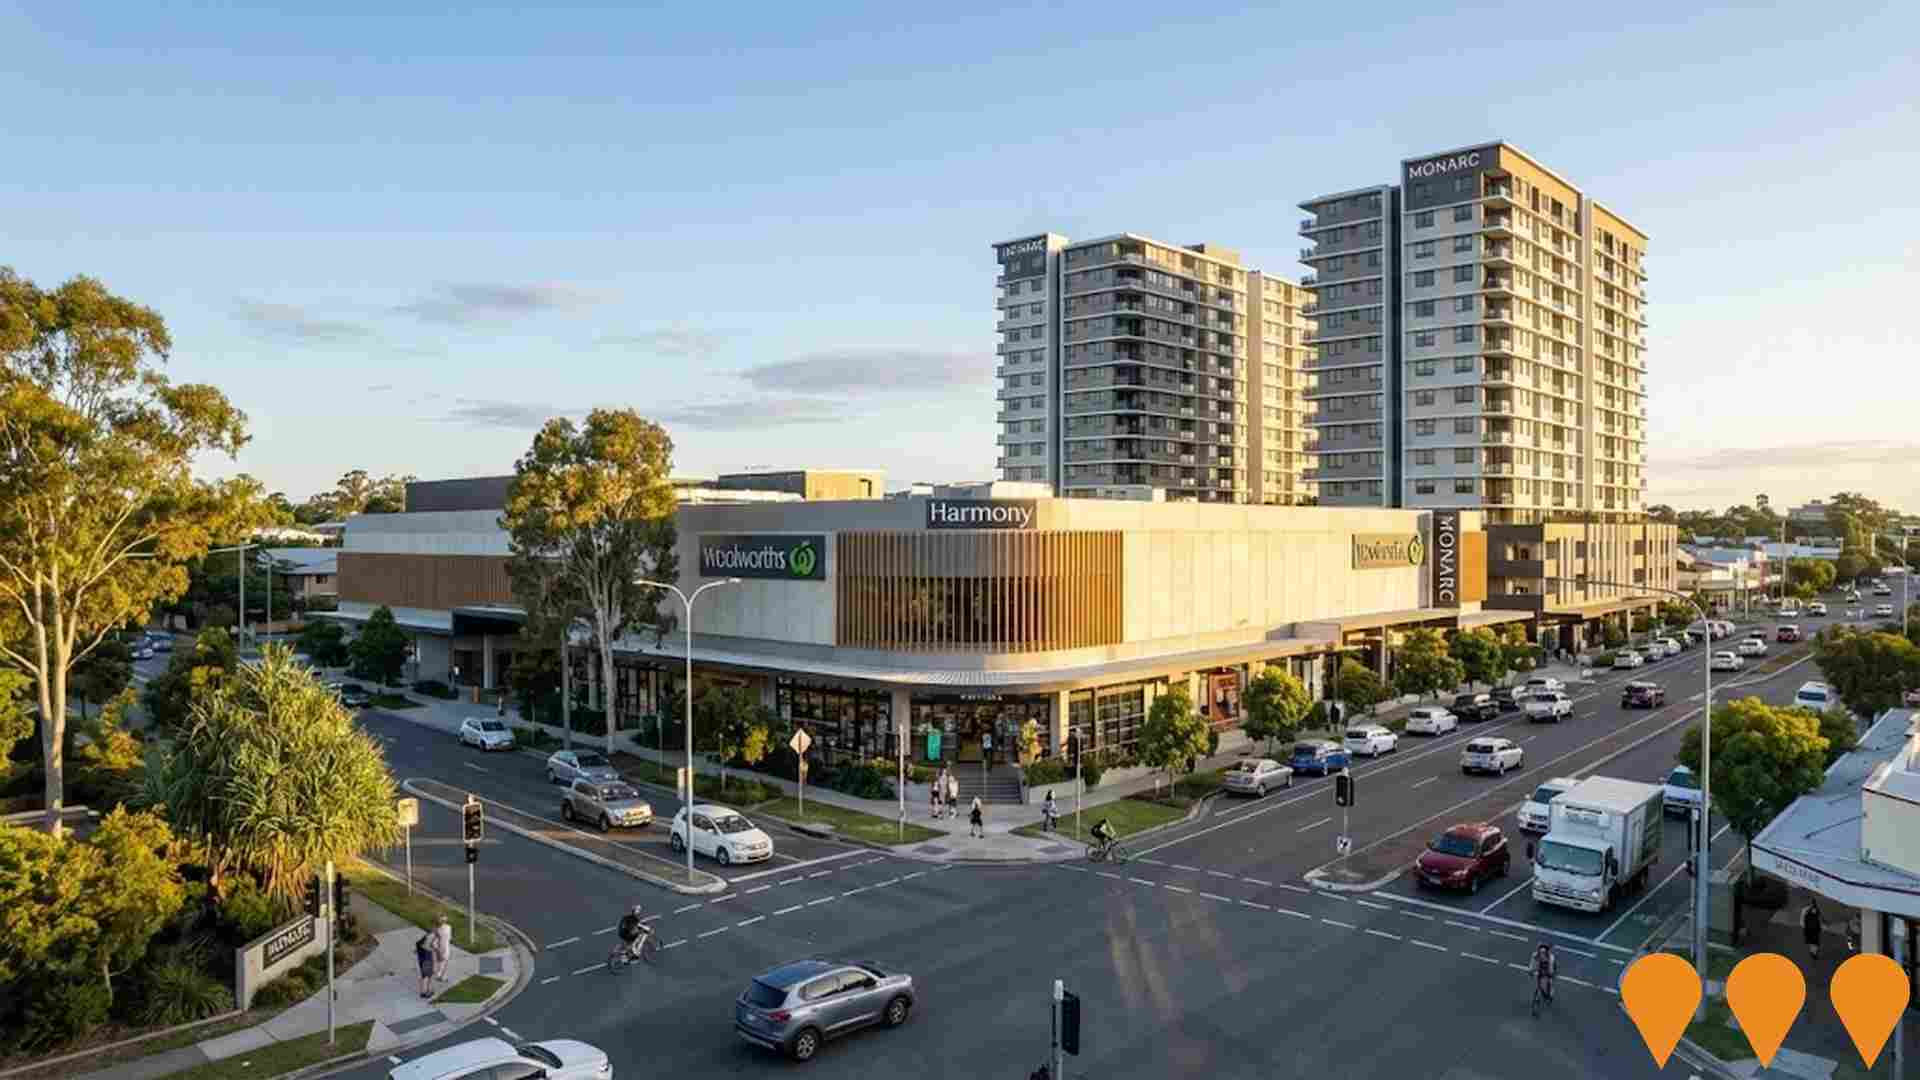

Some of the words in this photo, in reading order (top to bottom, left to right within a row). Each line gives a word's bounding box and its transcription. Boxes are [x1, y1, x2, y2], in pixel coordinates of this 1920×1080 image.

[1409, 153, 1480, 179] MONARC
[931, 503, 1033, 528] Harmony
[703, 544, 786, 571] Woolworths
[1439, 515, 1455, 602] MONARC
